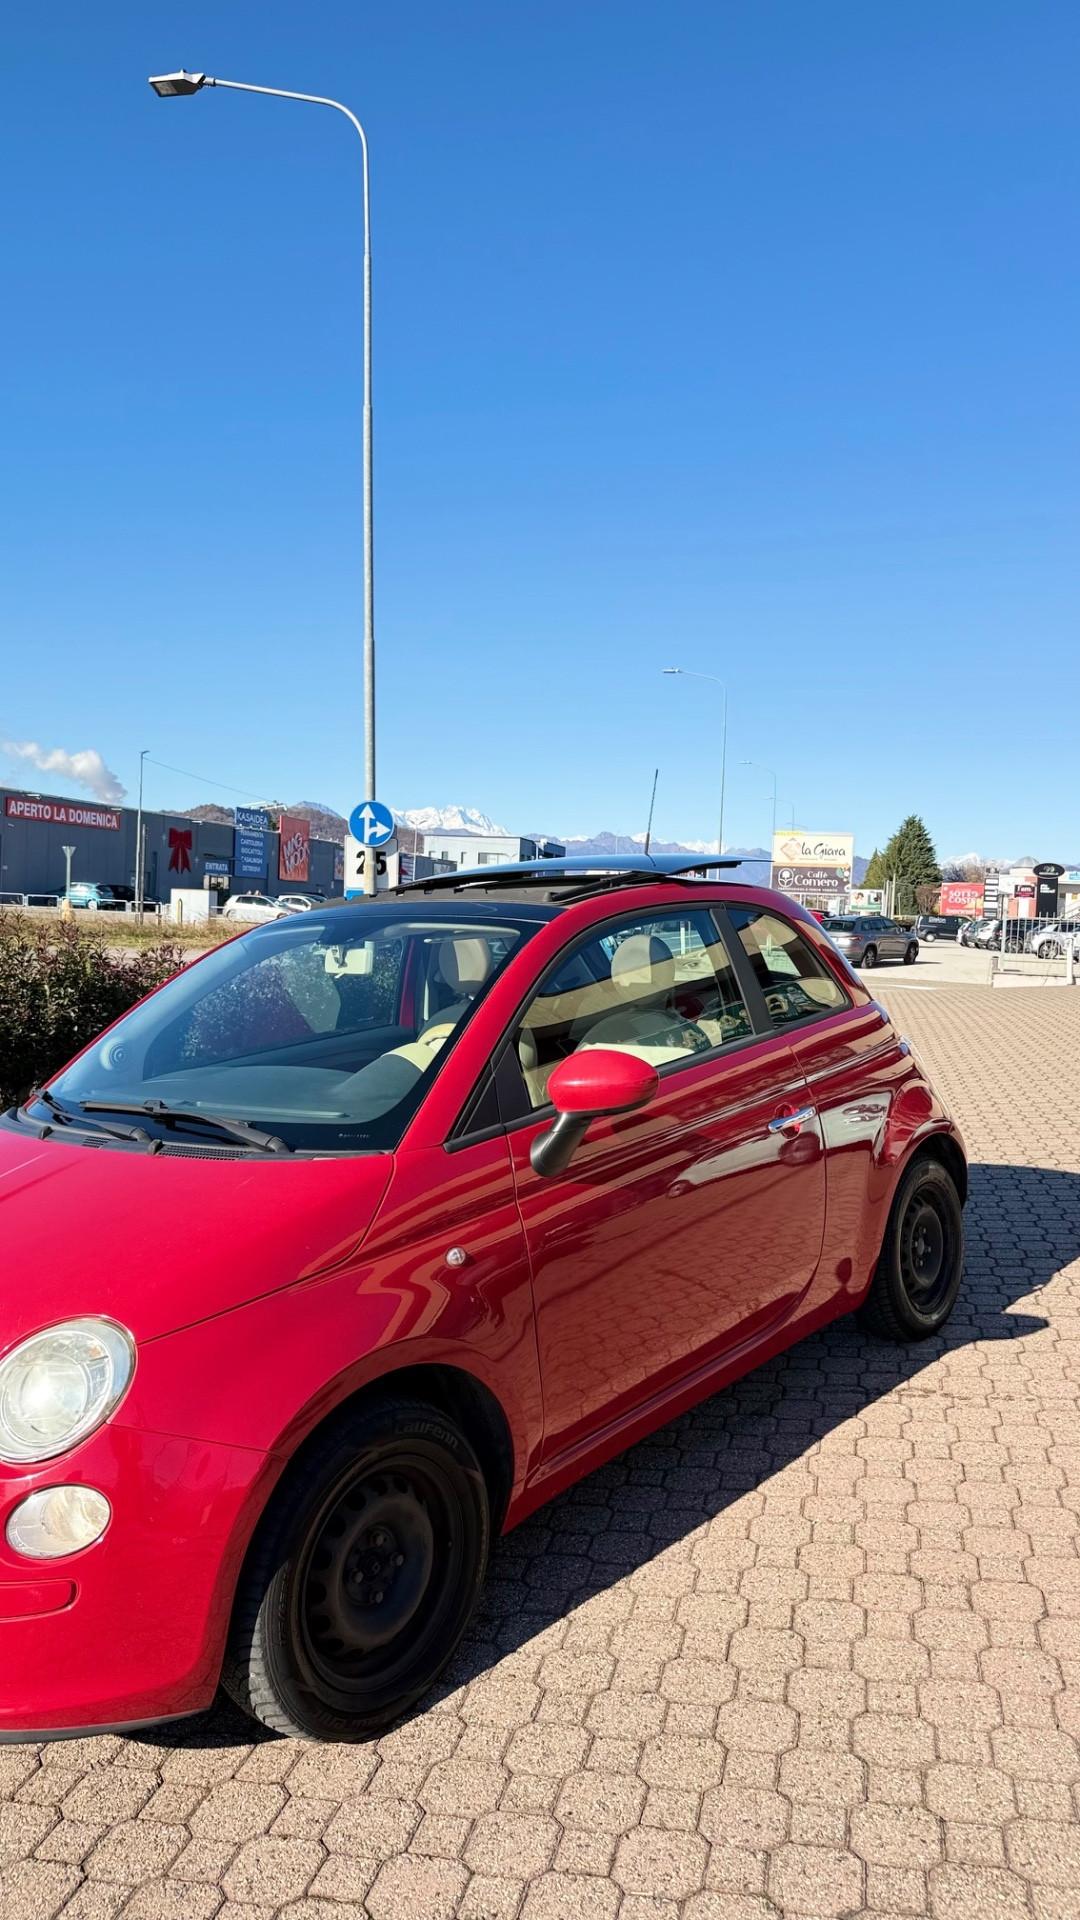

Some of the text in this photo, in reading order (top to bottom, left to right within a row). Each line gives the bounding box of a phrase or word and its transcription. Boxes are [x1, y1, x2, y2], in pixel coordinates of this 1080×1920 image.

[9, 800, 118, 828] APERTO LA DOMENICA
[238, 812, 268, 825] KASAIDEA
[813, 842, 846, 858] Giara
[205, 862, 228, 872] ENTRATA
[794, 874, 839, 887] Comero
